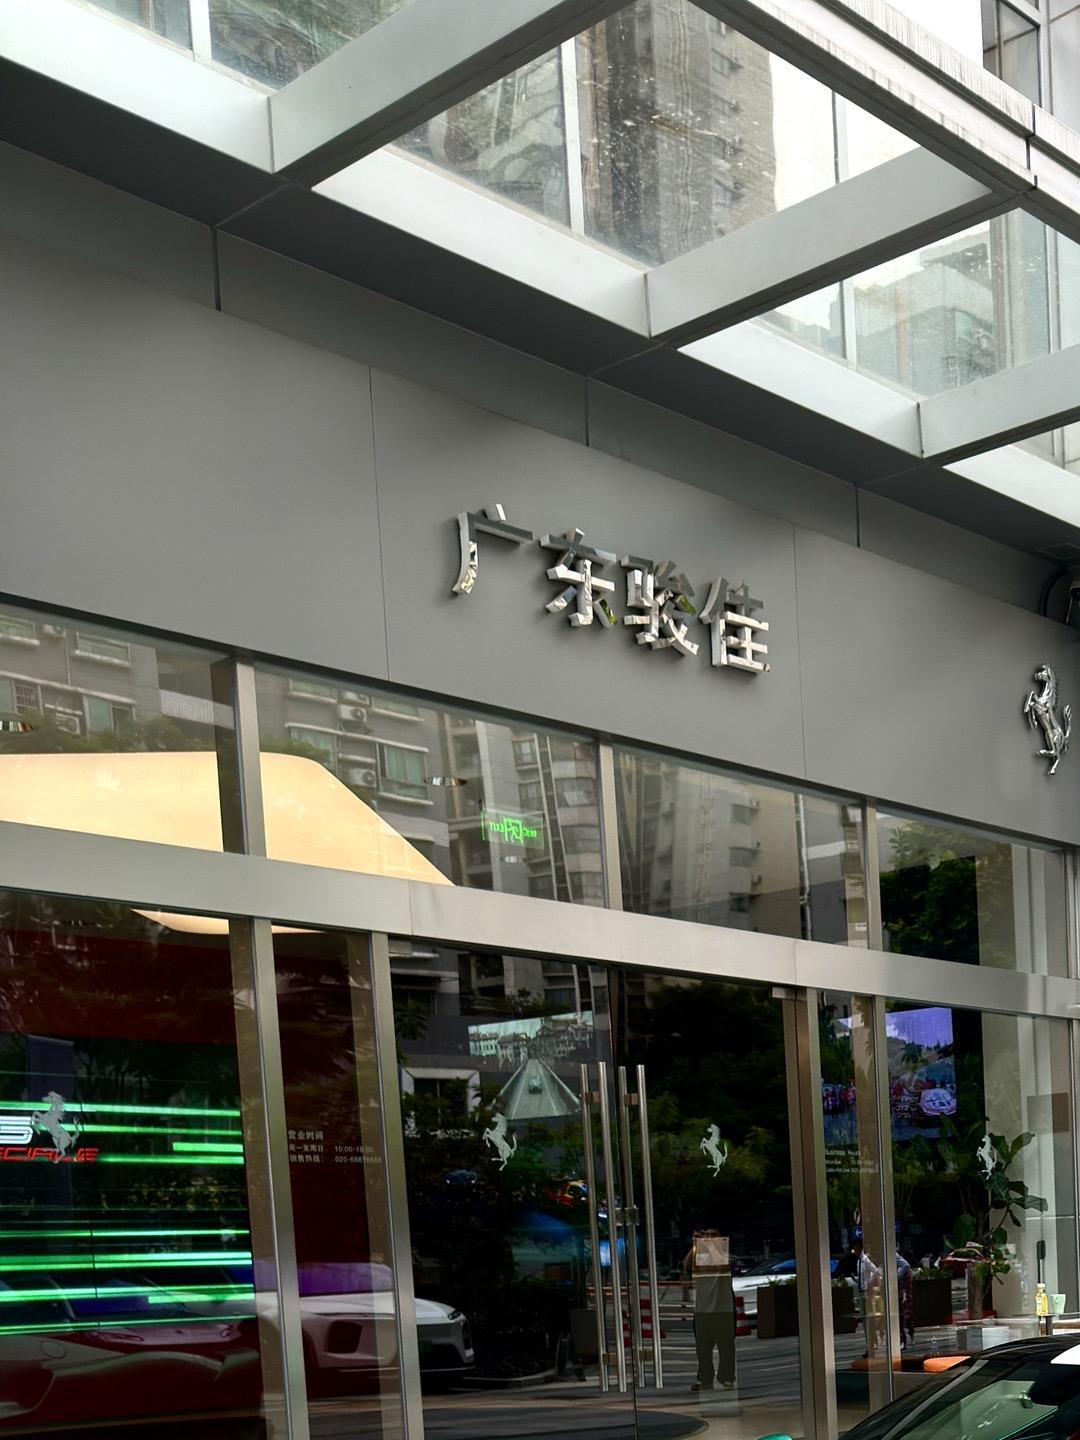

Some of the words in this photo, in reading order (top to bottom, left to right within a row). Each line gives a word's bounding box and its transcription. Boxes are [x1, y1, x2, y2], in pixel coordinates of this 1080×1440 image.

[451, 503, 771, 673] 广东骏佳
[288, 1130, 324, 1140] 营业时间
